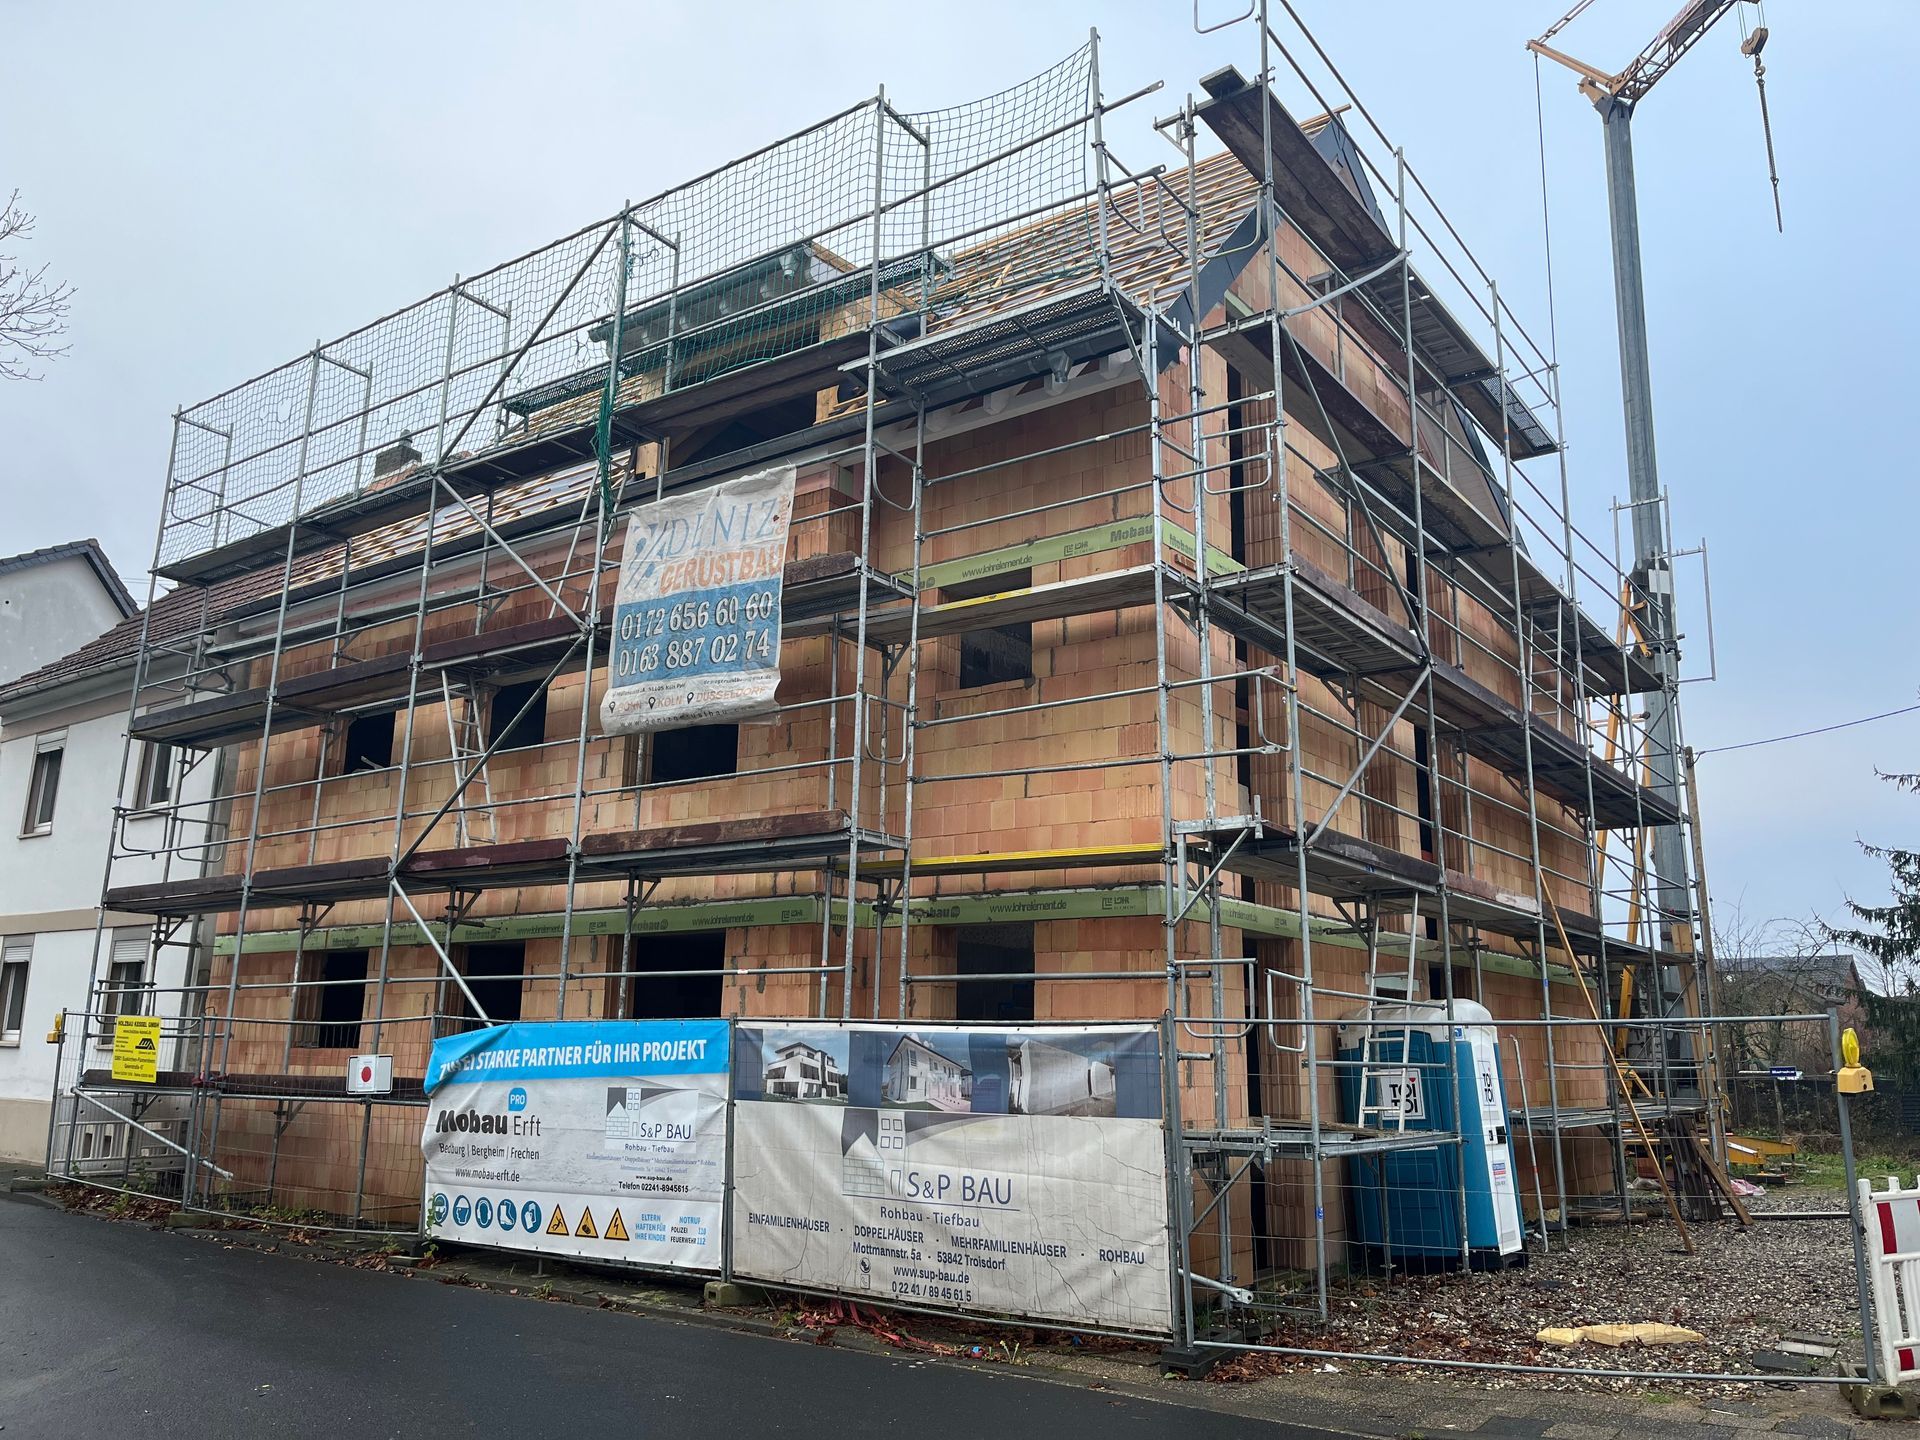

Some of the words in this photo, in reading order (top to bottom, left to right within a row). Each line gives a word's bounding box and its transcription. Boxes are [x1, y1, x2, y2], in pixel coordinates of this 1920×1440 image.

[961, 554, 1033, 579] www.lohrelement.de
[1110, 524, 1153, 543] Mobau
[659, 543, 784, 595] GERÜSTBAU
[620, 607, 665, 641] 0172
[669, 601, 710, 631] 656
[715, 595, 739, 626] 60
[745, 591, 773, 621] 60
[618, 643, 660, 677] 0163
[665, 636, 706, 669] 887
[710, 633, 738, 663] 02
[744, 628, 770, 660] 74
[989, 899, 1067, 913] www.lohrelement.de
[476, 1049, 521, 1070] STARKE
[521, 1046, 582, 1067] PARTNER
[584, 1040, 612, 1065] FÜR
[614, 1042, 641, 1063] IHR
[642, 1039, 707, 1062] PROJEKT
[1389, 1078, 1417, 1098] TOI
[510, 1094, 526, 1105] PRO
[435, 1109, 508, 1135] Mobau
[513, 1115, 542, 1137] Erft
[640, 1122, 662, 1138] S&P
[666, 1123, 692, 1140] BAU
[471, 1144, 505, 1159] Bergheim
[510, 1147, 540, 1160] Frechen
[624, 1143, 647, 1152] Rohbau
[652, 1144, 675, 1153] Tiefbau
[455, 1168, 520, 1182] www.mobau-erft.de
[619, 1181, 641, 1190] Telefon
[641, 1183, 689, 1193] 02241-8945615
[906, 1171, 951, 1200] S&P
[962, 1175, 1012, 1205] BAU
[641, 1213, 662, 1222] ELTERN
[679, 1216, 701, 1225] NOTRUF
[880, 1206, 923, 1222] Rohbau
[933, 1212, 980, 1228] Tiefbau
[635, 1223, 656, 1231] HAFTEN
[670, 1226, 688, 1234] POLIZEI
[635, 1232, 648, 1240] IHRE
[648, 1233, 666, 1242] KINDER
[670, 1237, 696, 1245] FEUERWEHR
[748, 1212, 830, 1233] EINFAMILIENHÄUSER
[854, 1225, 924, 1244] DOPPELHÄUSER
[951, 1235, 1067, 1258] MEHRFAMILIENHÄUSER
[1099, 1248, 1145, 1265] ROHBAU
[853, 1241, 909, 1260] Mottmannstr.
[910, 1248, 922, 1261] 5a
[937, 1251, 963, 1266] 53842
[964, 1254, 1006, 1271] Troisdorf
[893, 1265, 970, 1284] www.sup-bau.de
